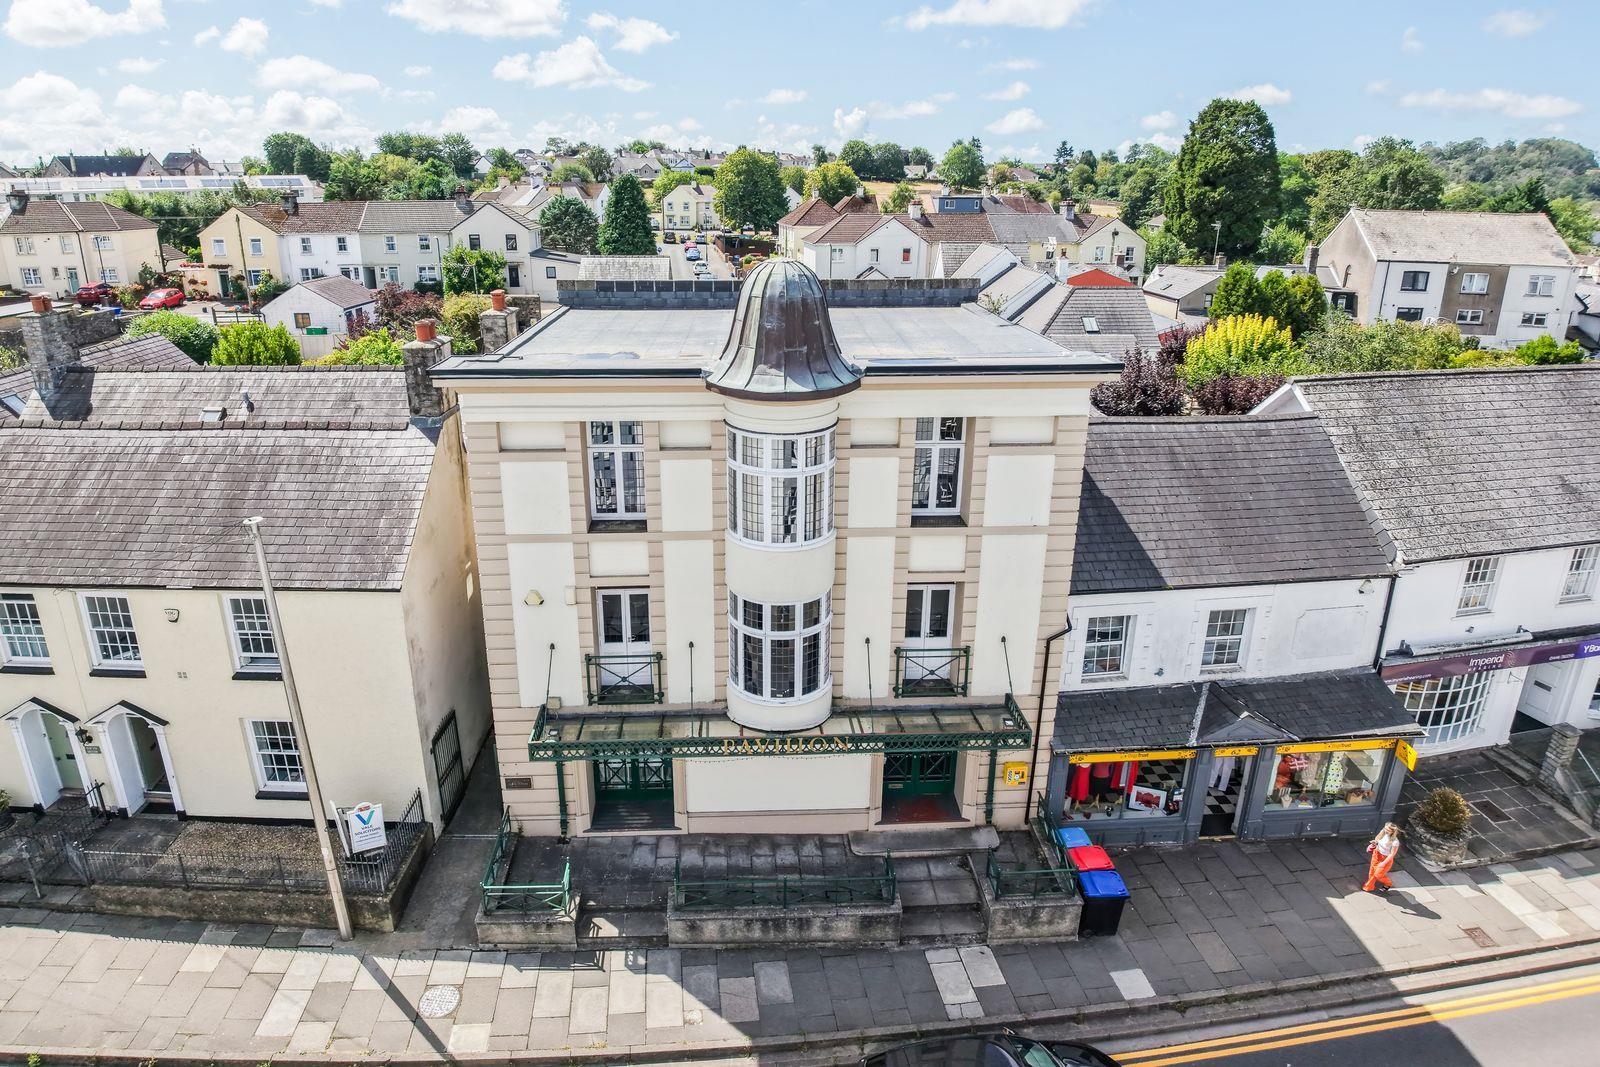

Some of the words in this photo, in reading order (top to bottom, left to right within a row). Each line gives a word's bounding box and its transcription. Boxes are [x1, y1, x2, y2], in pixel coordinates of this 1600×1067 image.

[1469, 653, 1505, 667] Imperial
[723, 735, 850, 755] PAVILION
[354, 826, 381, 836] SOLICITORS
